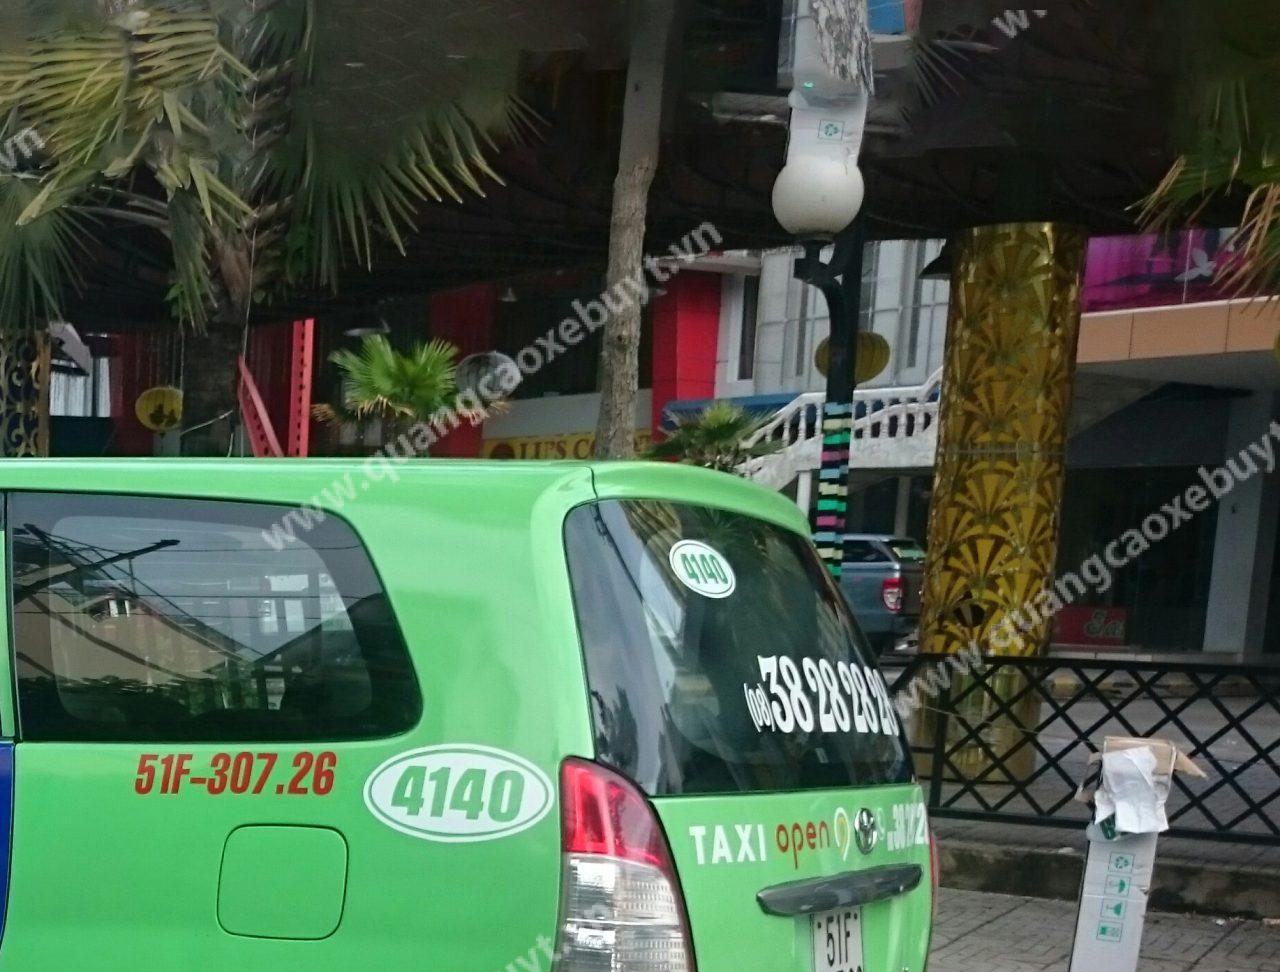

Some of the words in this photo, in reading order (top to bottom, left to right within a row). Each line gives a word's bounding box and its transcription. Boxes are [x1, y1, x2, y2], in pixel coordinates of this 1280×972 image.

[680, 553, 729, 584] 4140
[758, 655, 814, 733] 38
[802, 657, 851, 732] 28
[837, 661, 879, 733] 28
[134, 751, 337, 796] 51F-307.26
[390, 764, 527, 824] 4140
[688, 823, 767, 865] TAXI
[775, 820, 831, 870] open
[826, 912, 852, 968] 51F
